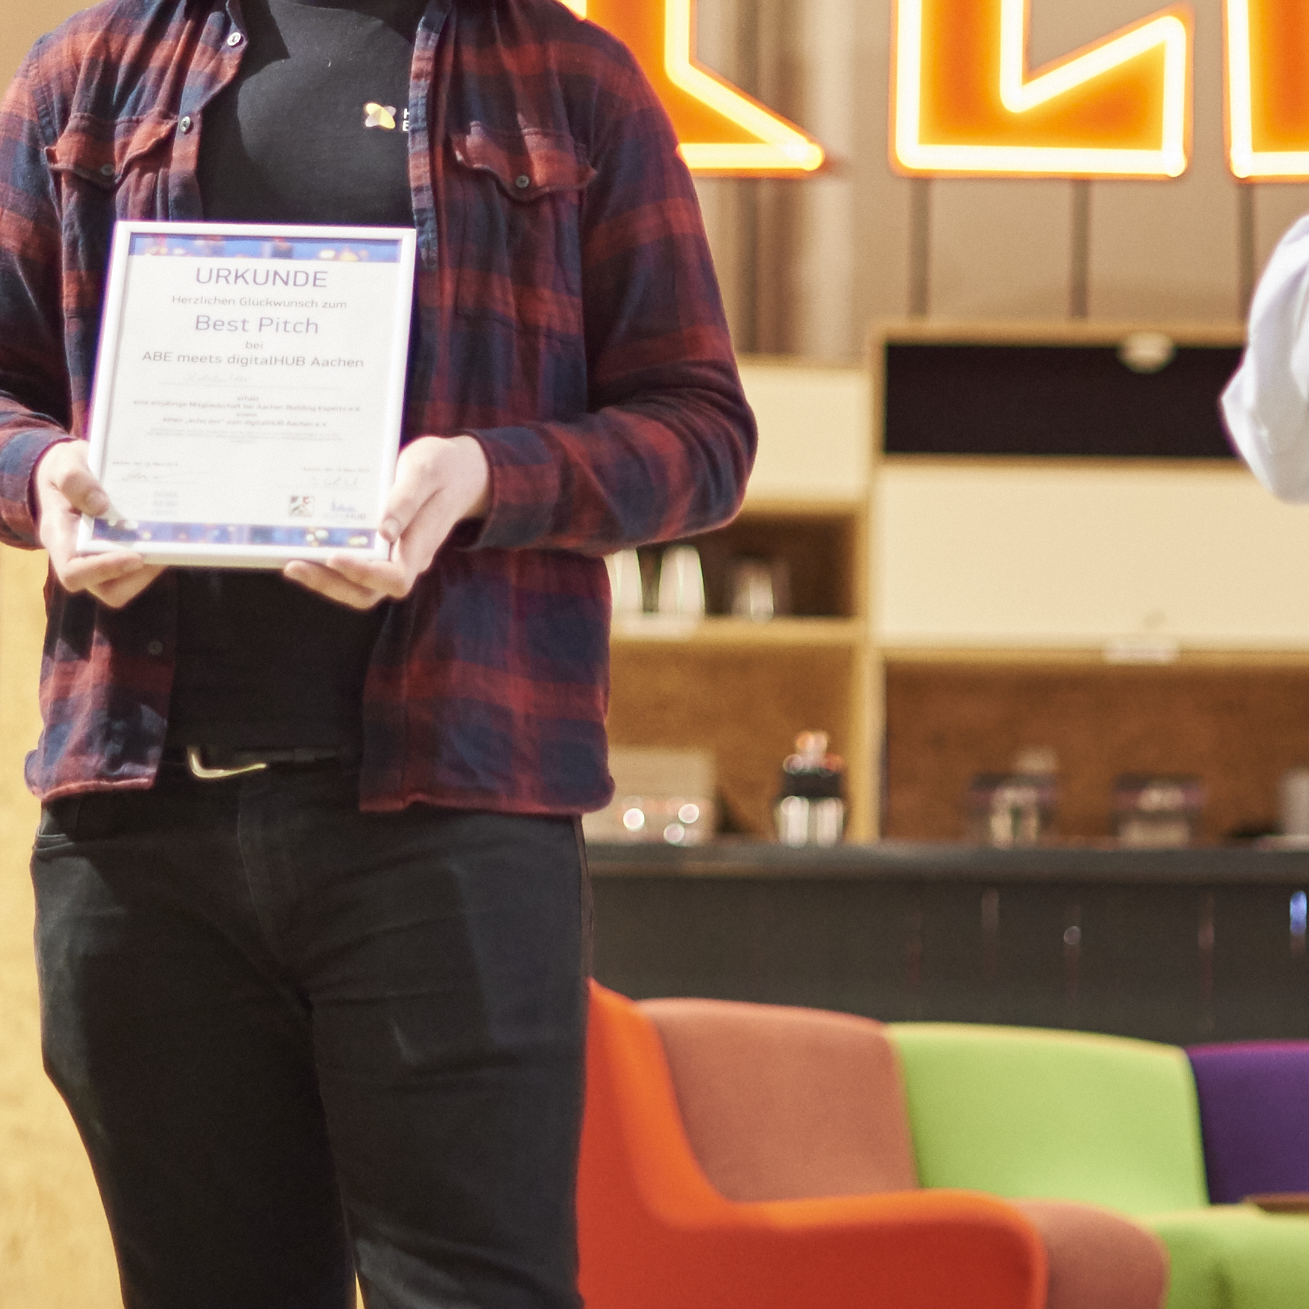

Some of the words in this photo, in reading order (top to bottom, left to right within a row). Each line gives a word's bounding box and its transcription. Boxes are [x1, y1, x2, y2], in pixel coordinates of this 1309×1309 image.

[195, 267, 329, 288] URKUNDE
[171, 295, 236, 306] Herzlichen
[239, 297, 318, 308] Glückwunsch
[322, 301, 347, 309] zum
[194, 314, 250, 332] Best
[258, 316, 319, 334] Pitch
[245, 340, 264, 350] bei
[142, 351, 173, 362] ABE
[177, 354, 222, 363] meets
[227, 354, 306, 368] digitalHUB
[310, 357, 364, 368] Aachen
